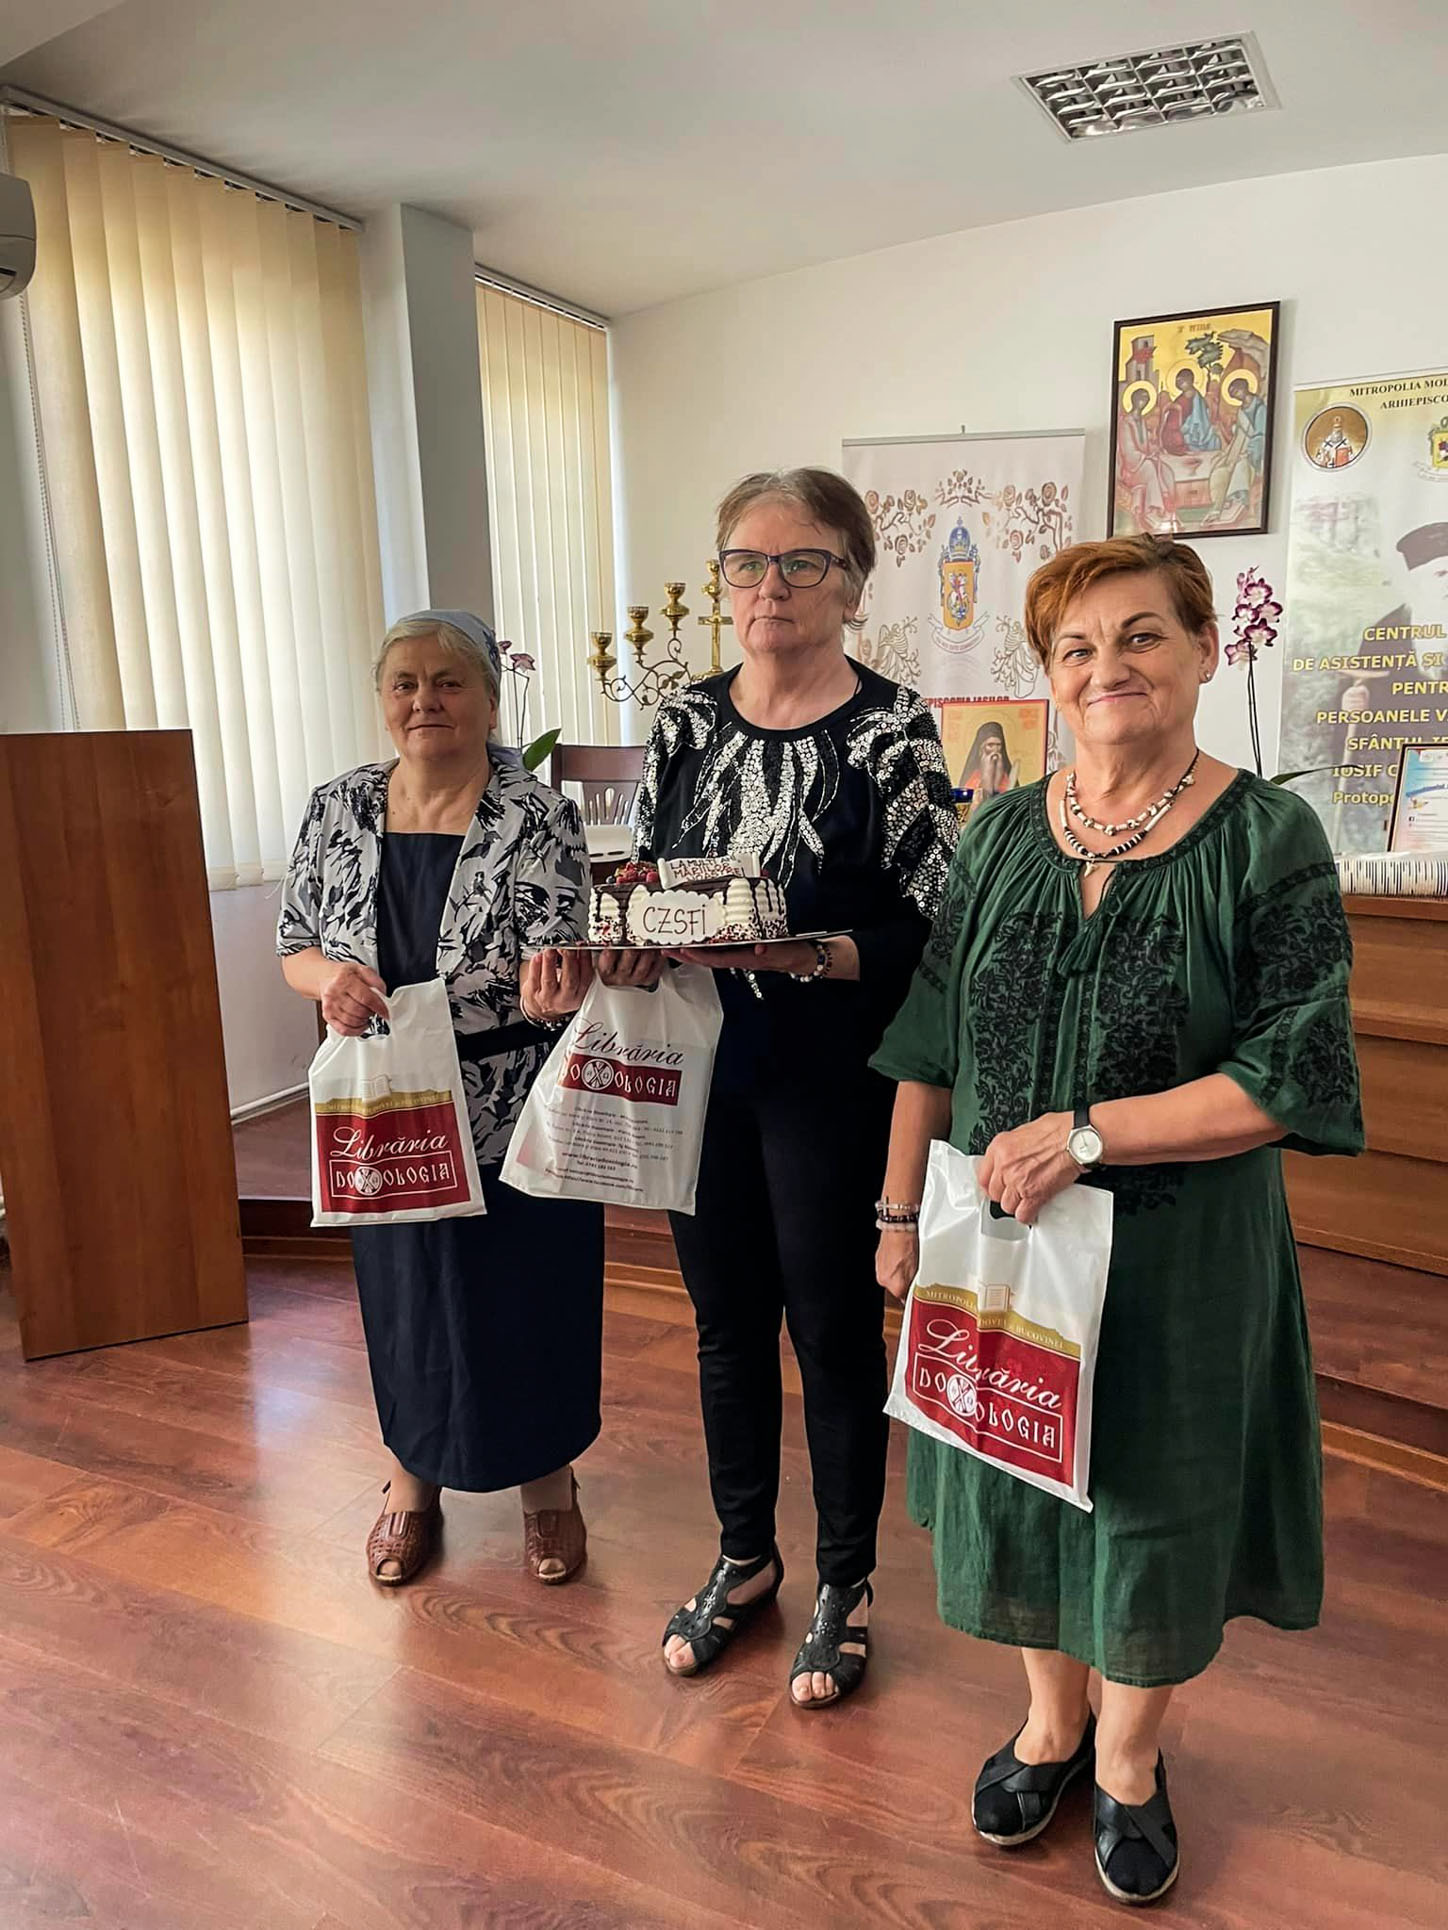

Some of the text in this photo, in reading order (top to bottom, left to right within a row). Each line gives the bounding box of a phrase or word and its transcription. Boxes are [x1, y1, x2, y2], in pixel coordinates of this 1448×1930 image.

[1350, 382, 1421, 397] MITROPOLIA
[1363, 624, 1447, 640] CENTRUL
[1292, 657, 1315, 671] DE
[1317, 709, 1430, 724] PERSOANELE
[1332, 763, 1383, 778] IOSIF
[329, 1126, 448, 1161] Librăria
